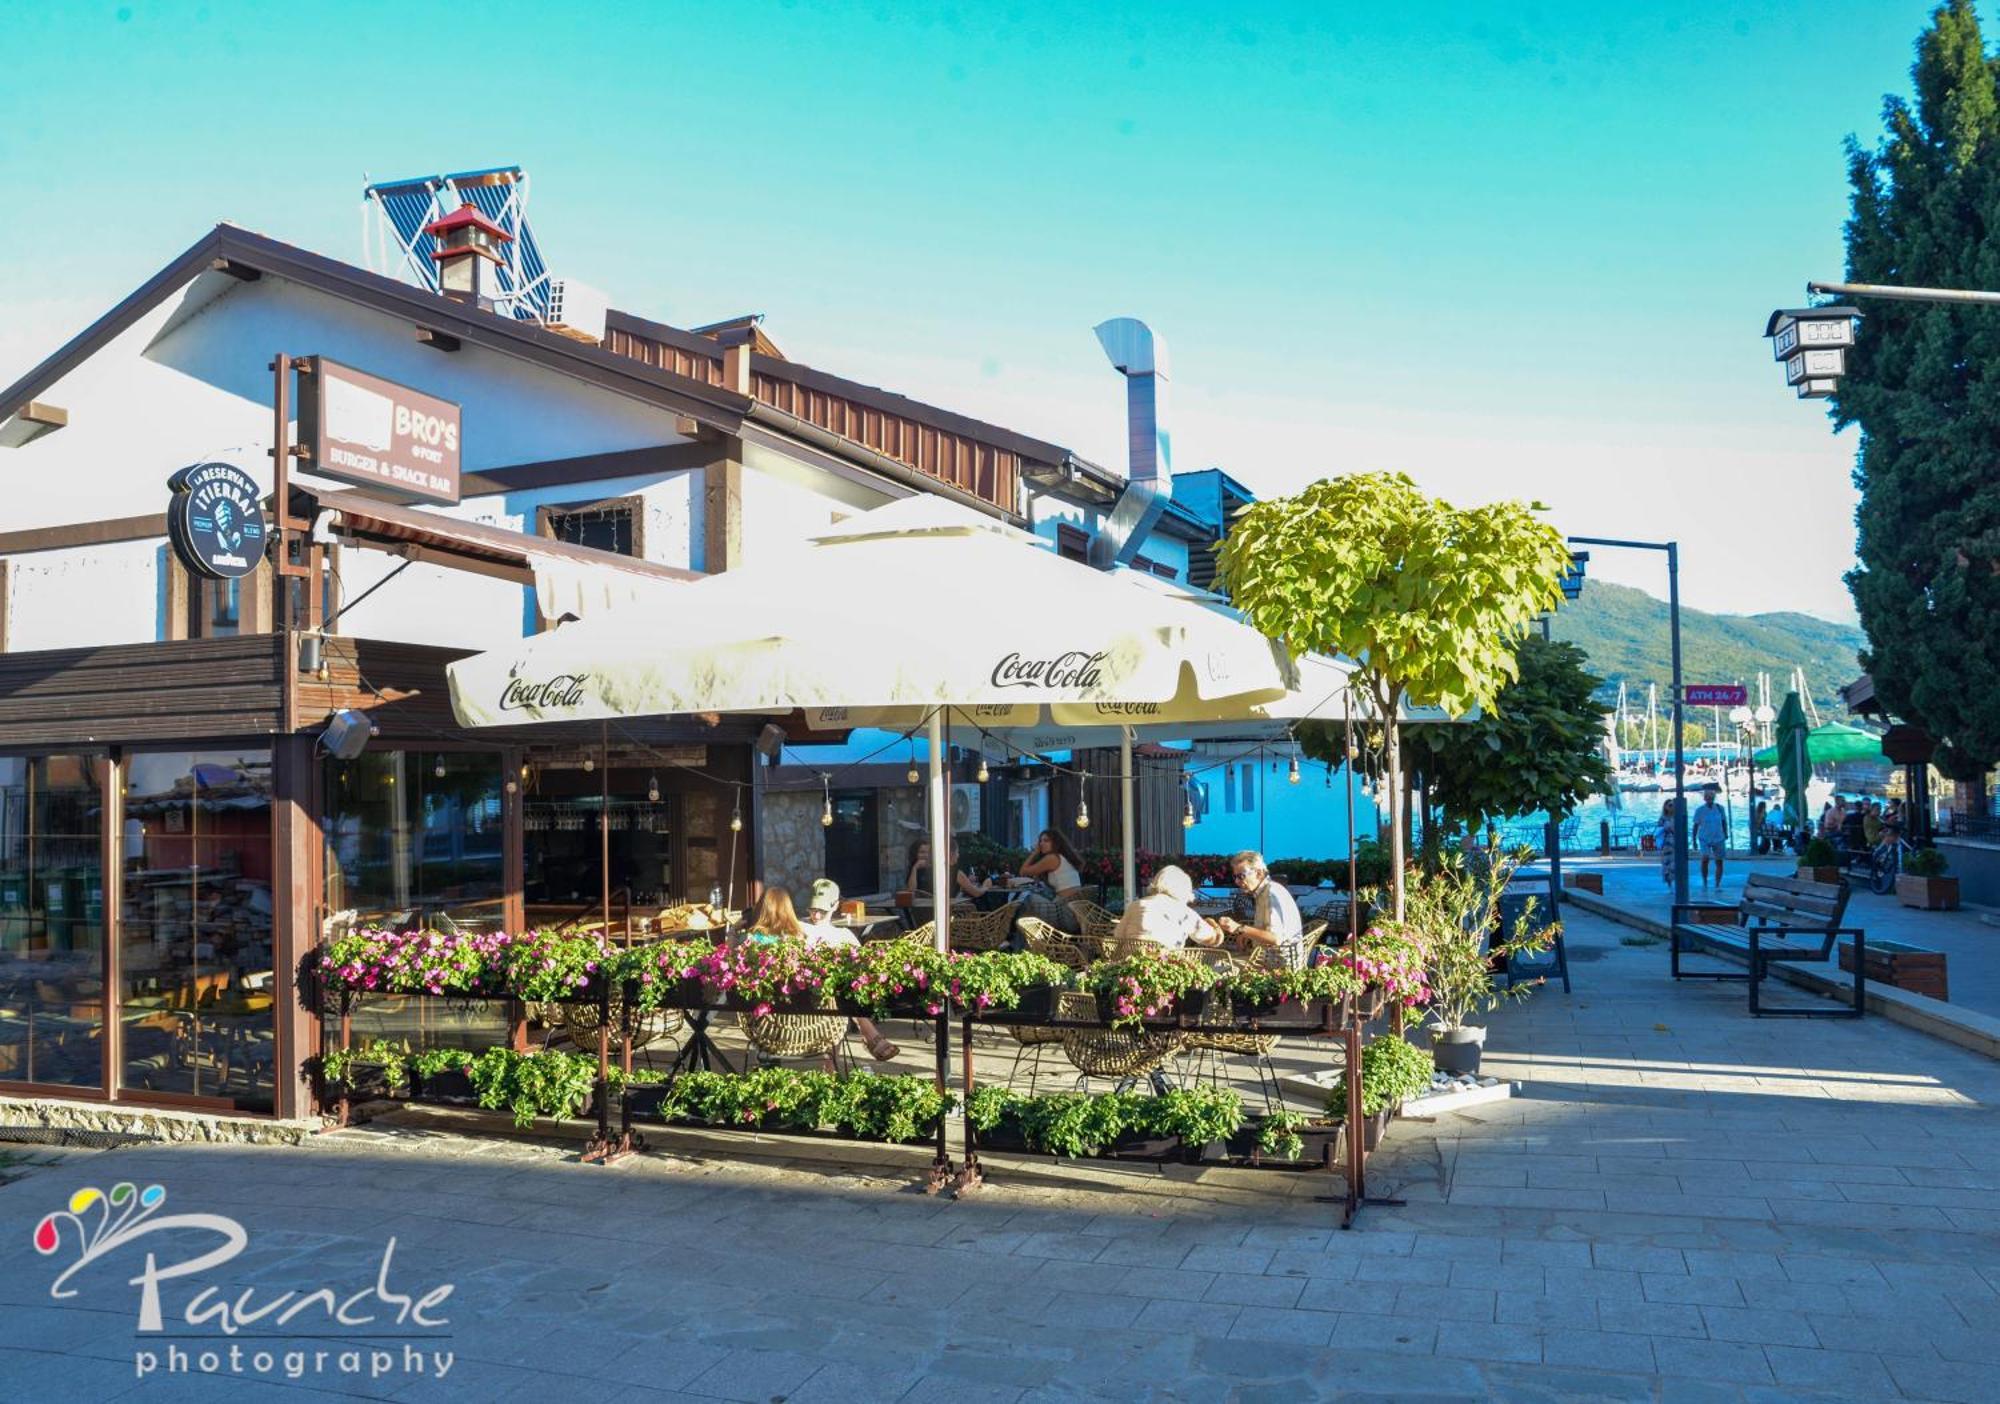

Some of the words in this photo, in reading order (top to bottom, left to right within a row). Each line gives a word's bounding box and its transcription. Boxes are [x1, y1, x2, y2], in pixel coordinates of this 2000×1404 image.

[395, 405, 457, 451] BRO'S
[201, 467, 245, 488] RESERVA
[330, 447, 378, 473] BURGER
[380, 461, 390, 477] &
[392, 465, 428, 487] SNACK
[429, 475, 451, 493] BAR
[991, 651, 1109, 688] Coca-Cola
[499, 674, 590, 711] Coca-Cola
[1690, 690, 1713, 700] ATM
